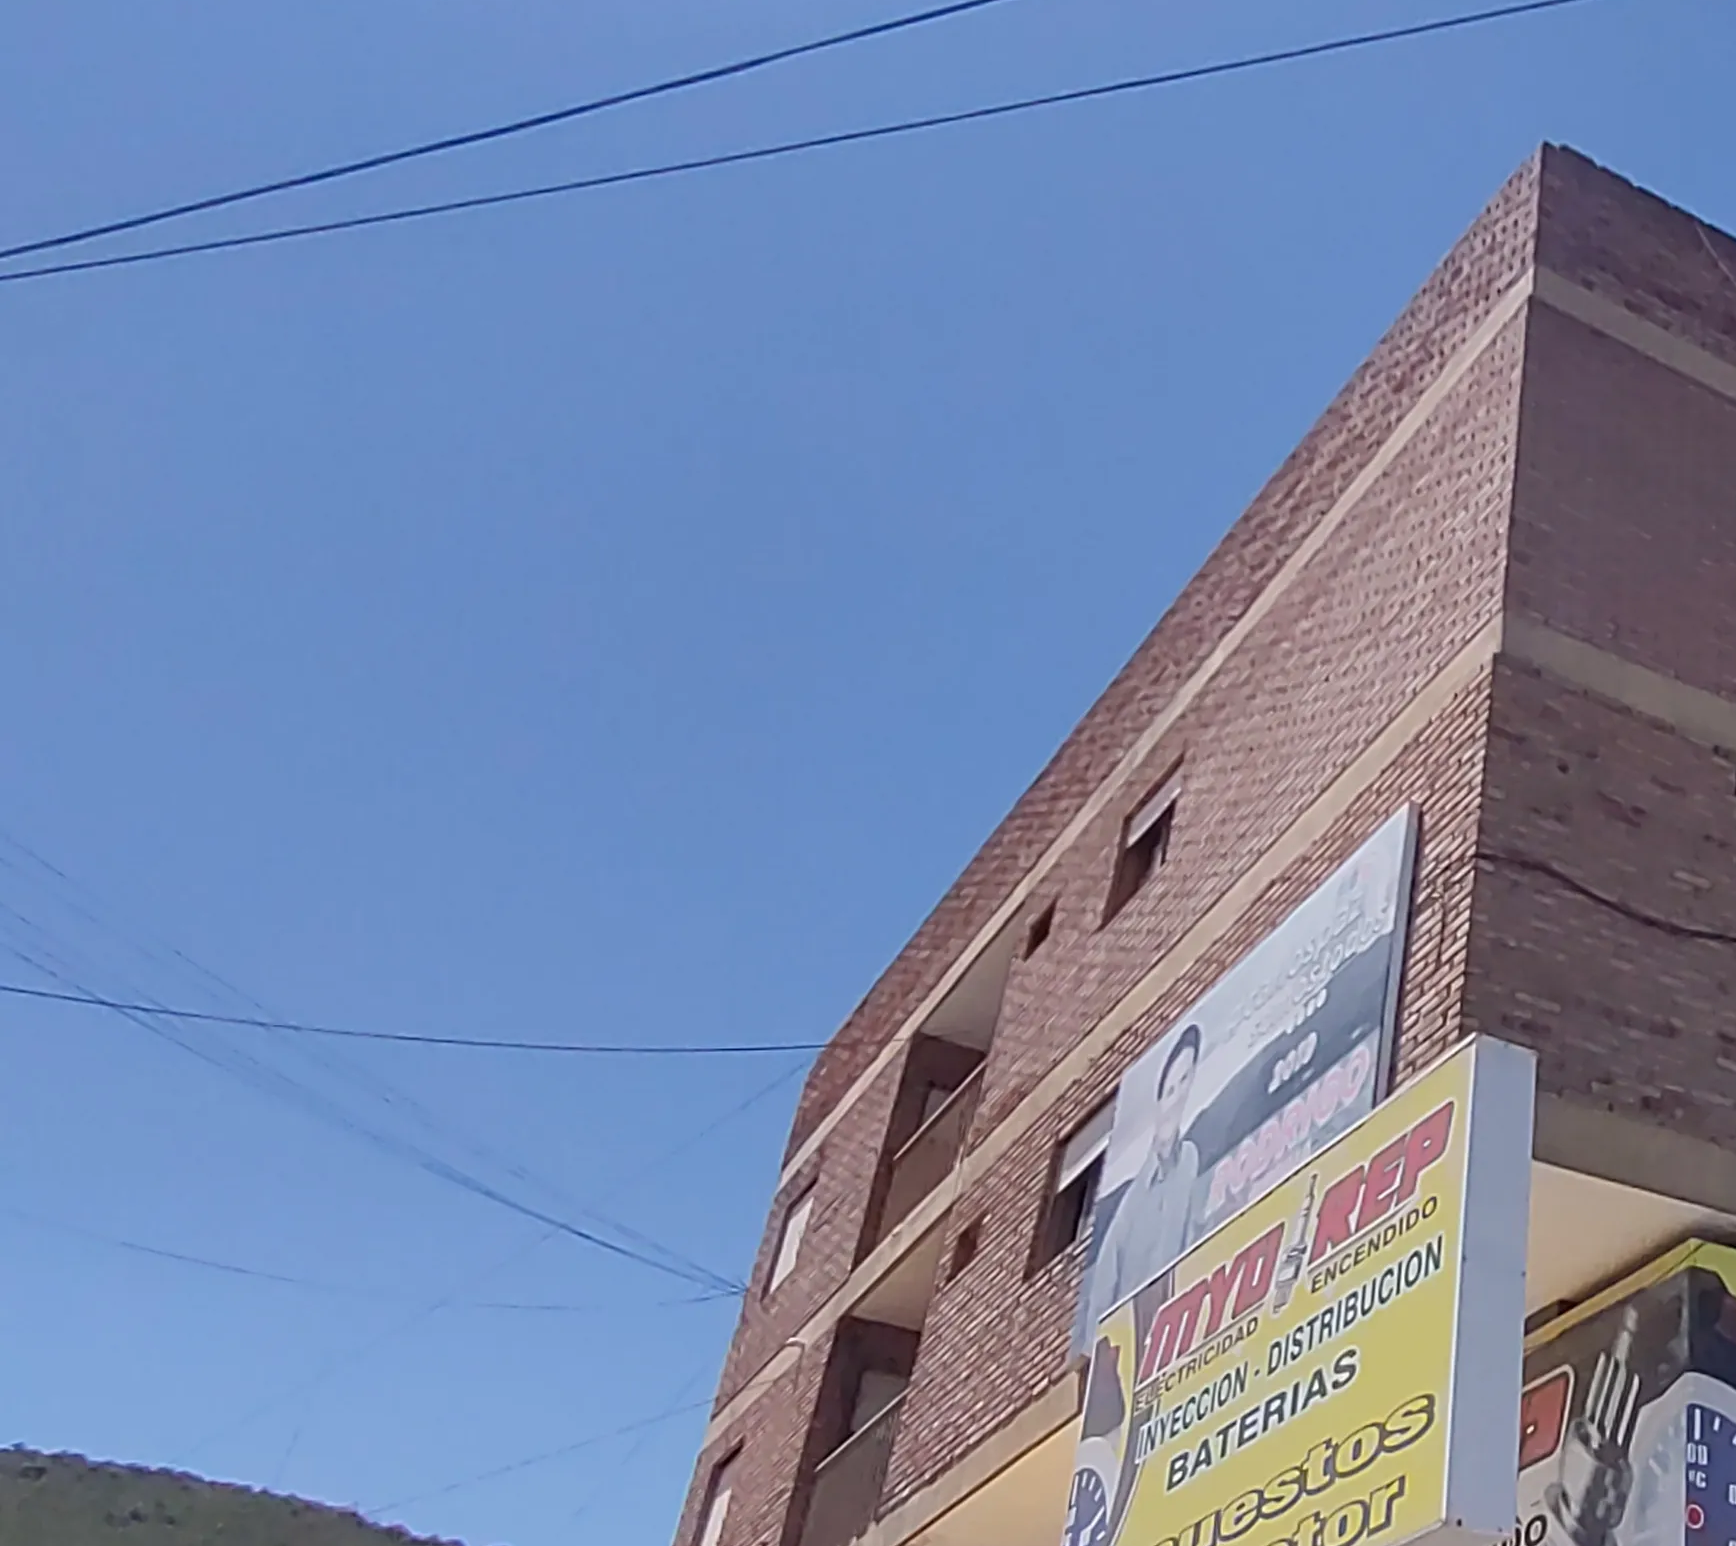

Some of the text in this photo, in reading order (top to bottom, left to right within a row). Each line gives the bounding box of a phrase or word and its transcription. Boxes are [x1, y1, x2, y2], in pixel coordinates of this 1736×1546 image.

[1307, 1101, 1455, 1266] REP
[1134, 1195, 1439, 1415] ELECTRICIDAD ENCENDIDO
[1136, 1361, 1249, 1459] INYECCION
[1266, 1236, 1444, 1375] DISTRIBUCION
[1165, 1349, 1358, 1491] BATERIAS
